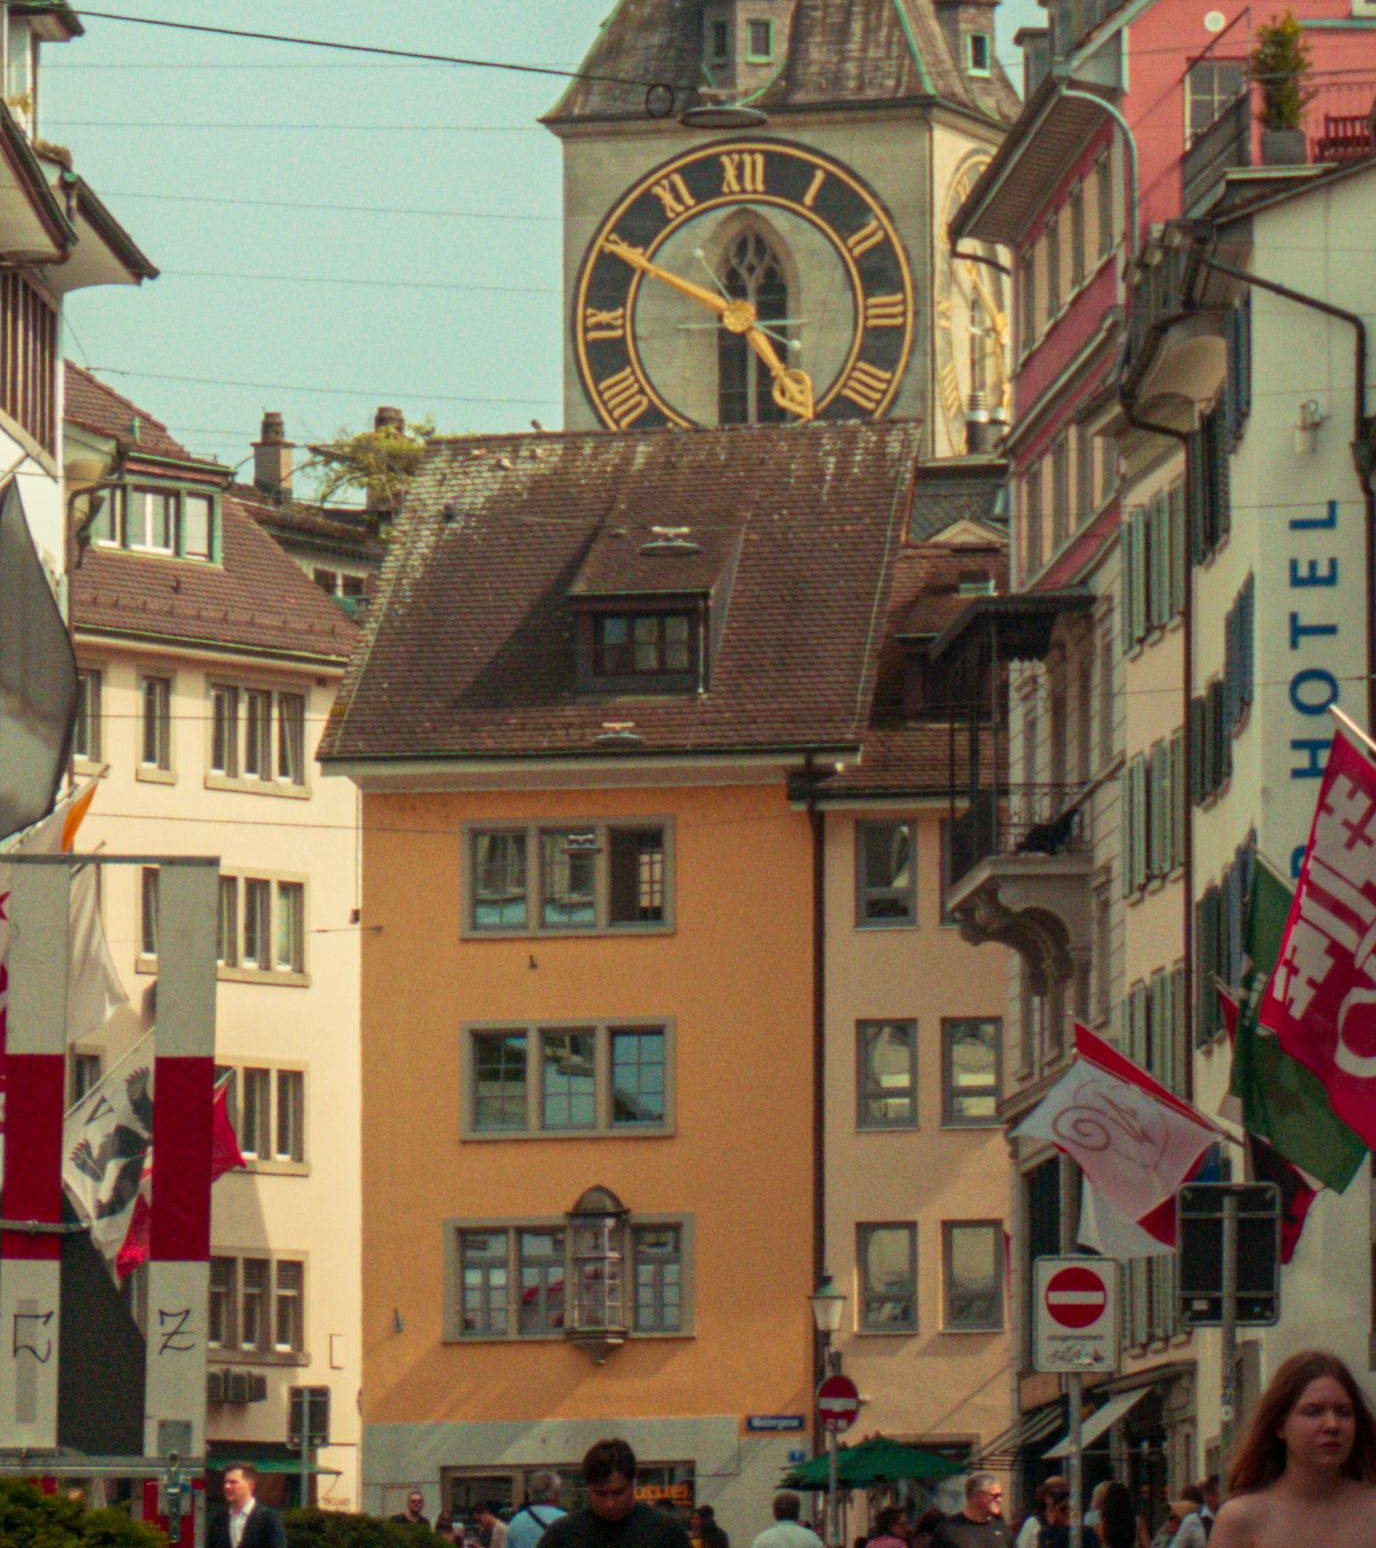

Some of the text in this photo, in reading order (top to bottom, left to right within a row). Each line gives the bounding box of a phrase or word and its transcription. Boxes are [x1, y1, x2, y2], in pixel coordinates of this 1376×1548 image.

[721, 152, 765, 193] XII
[650, 172, 696, 219] XI
[586, 307, 624, 342] IX
[866, 293, 905, 329] III
[1289, 499, 1339, 780] HOTEL
